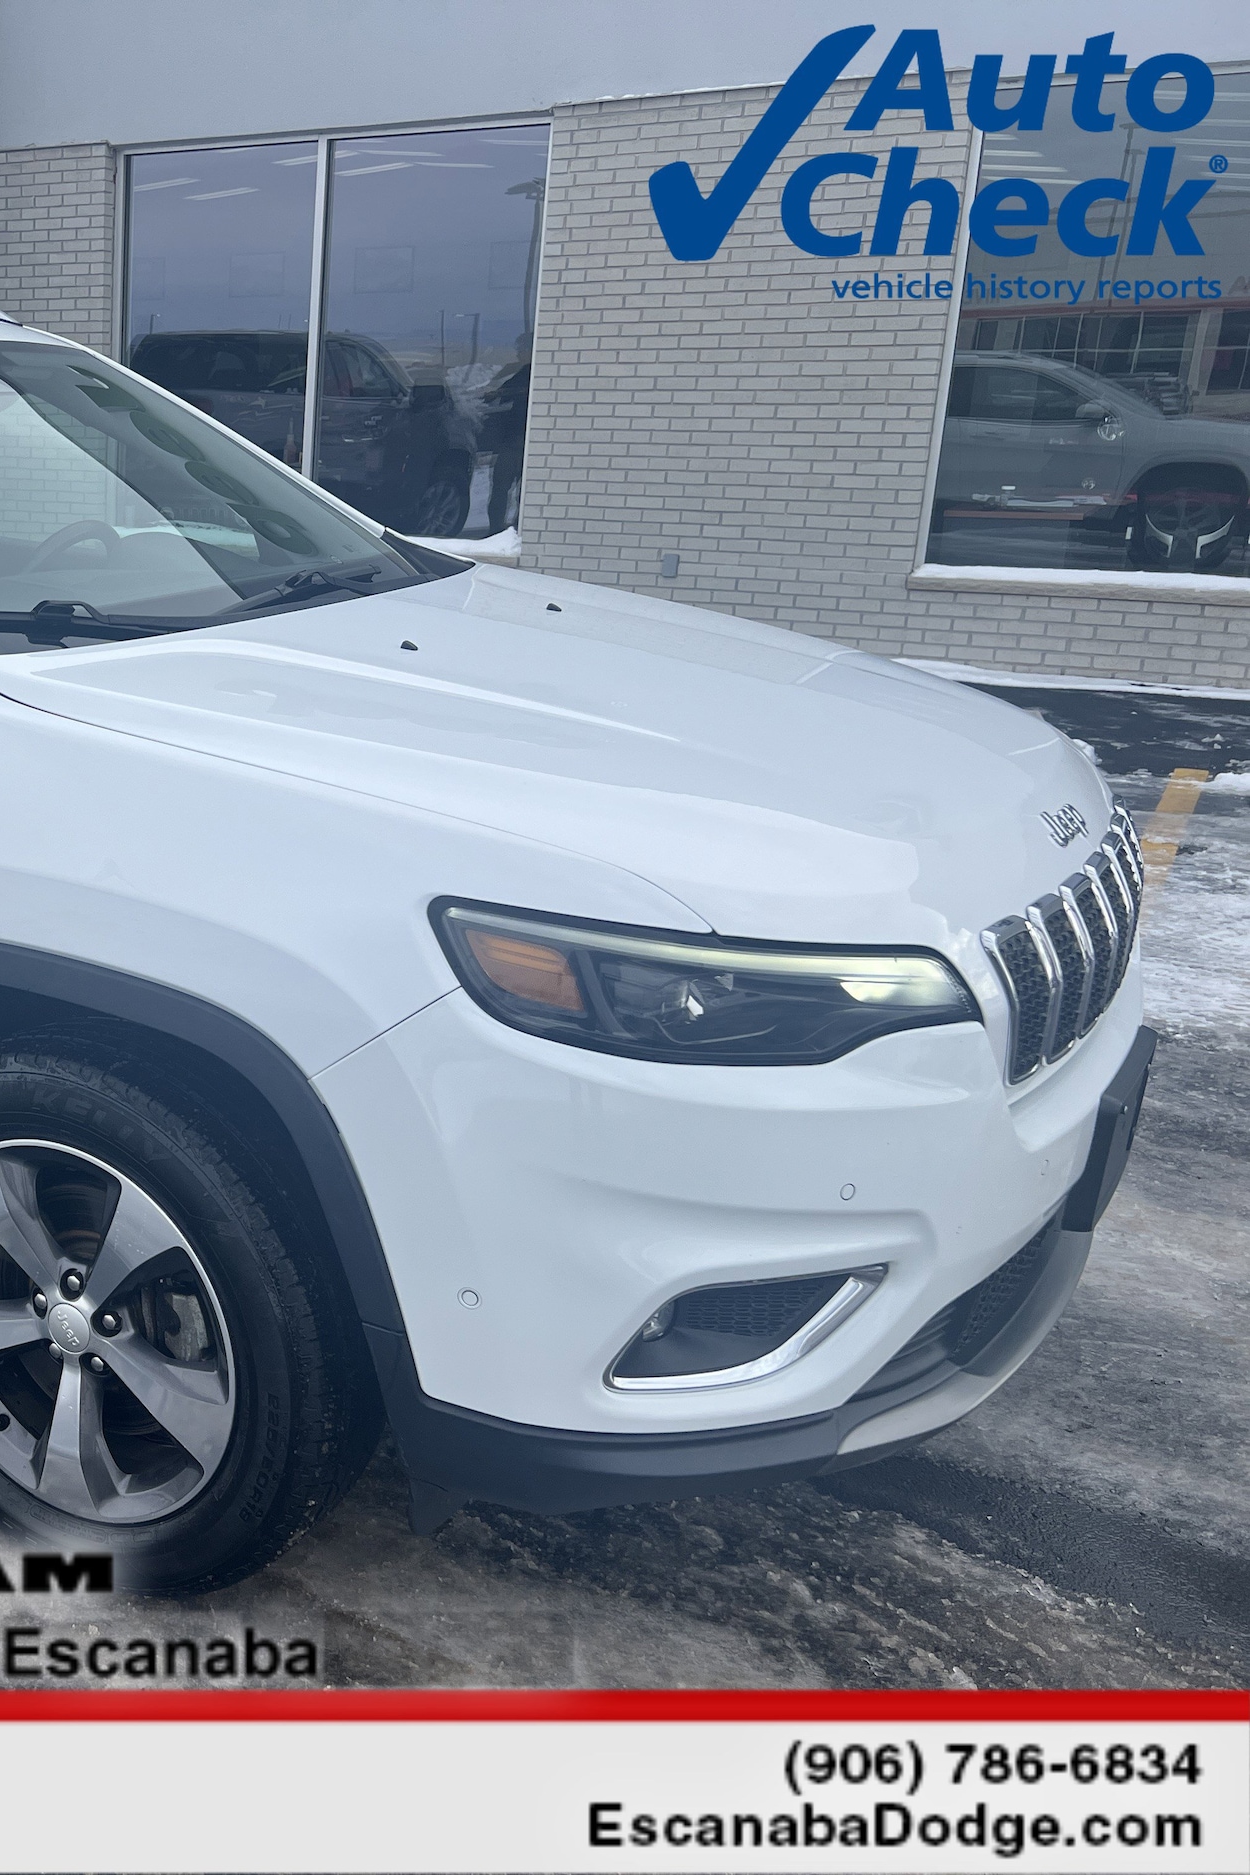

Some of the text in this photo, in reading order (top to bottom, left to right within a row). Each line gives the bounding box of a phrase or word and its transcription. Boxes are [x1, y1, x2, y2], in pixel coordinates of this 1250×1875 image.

[1040, 803, 1090, 848] Jeep
[33, 1086, 171, 1162] KELLY
[56, 1310, 81, 1347] Jeep
